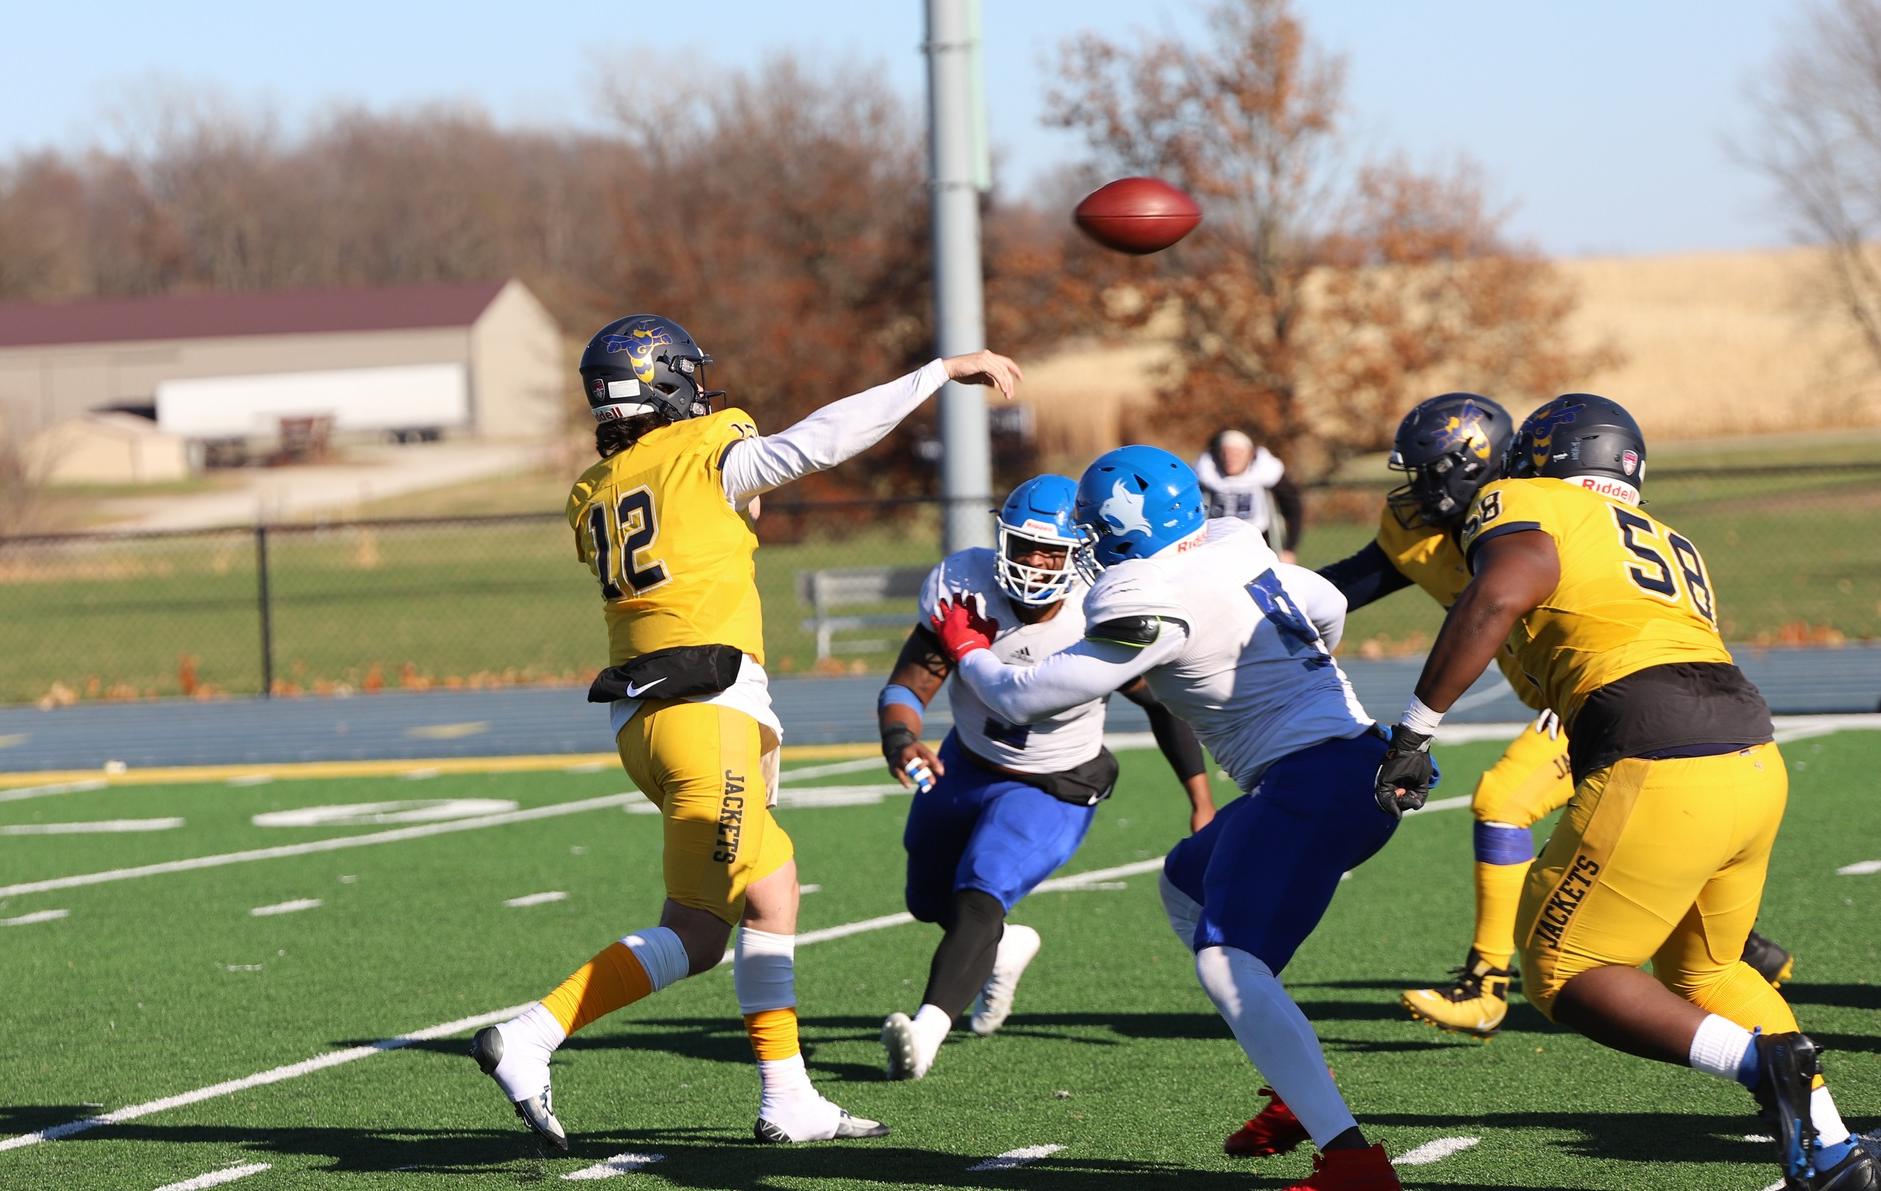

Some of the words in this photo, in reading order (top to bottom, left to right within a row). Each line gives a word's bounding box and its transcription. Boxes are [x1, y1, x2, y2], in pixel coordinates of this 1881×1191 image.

[1582, 479, 1636, 503] Riddell
[587, 484, 671, 600] 12
[1607, 503, 1718, 633] 58
[713, 769, 744, 864] JACKETS
[1536, 854, 1600, 949] JACKETS
